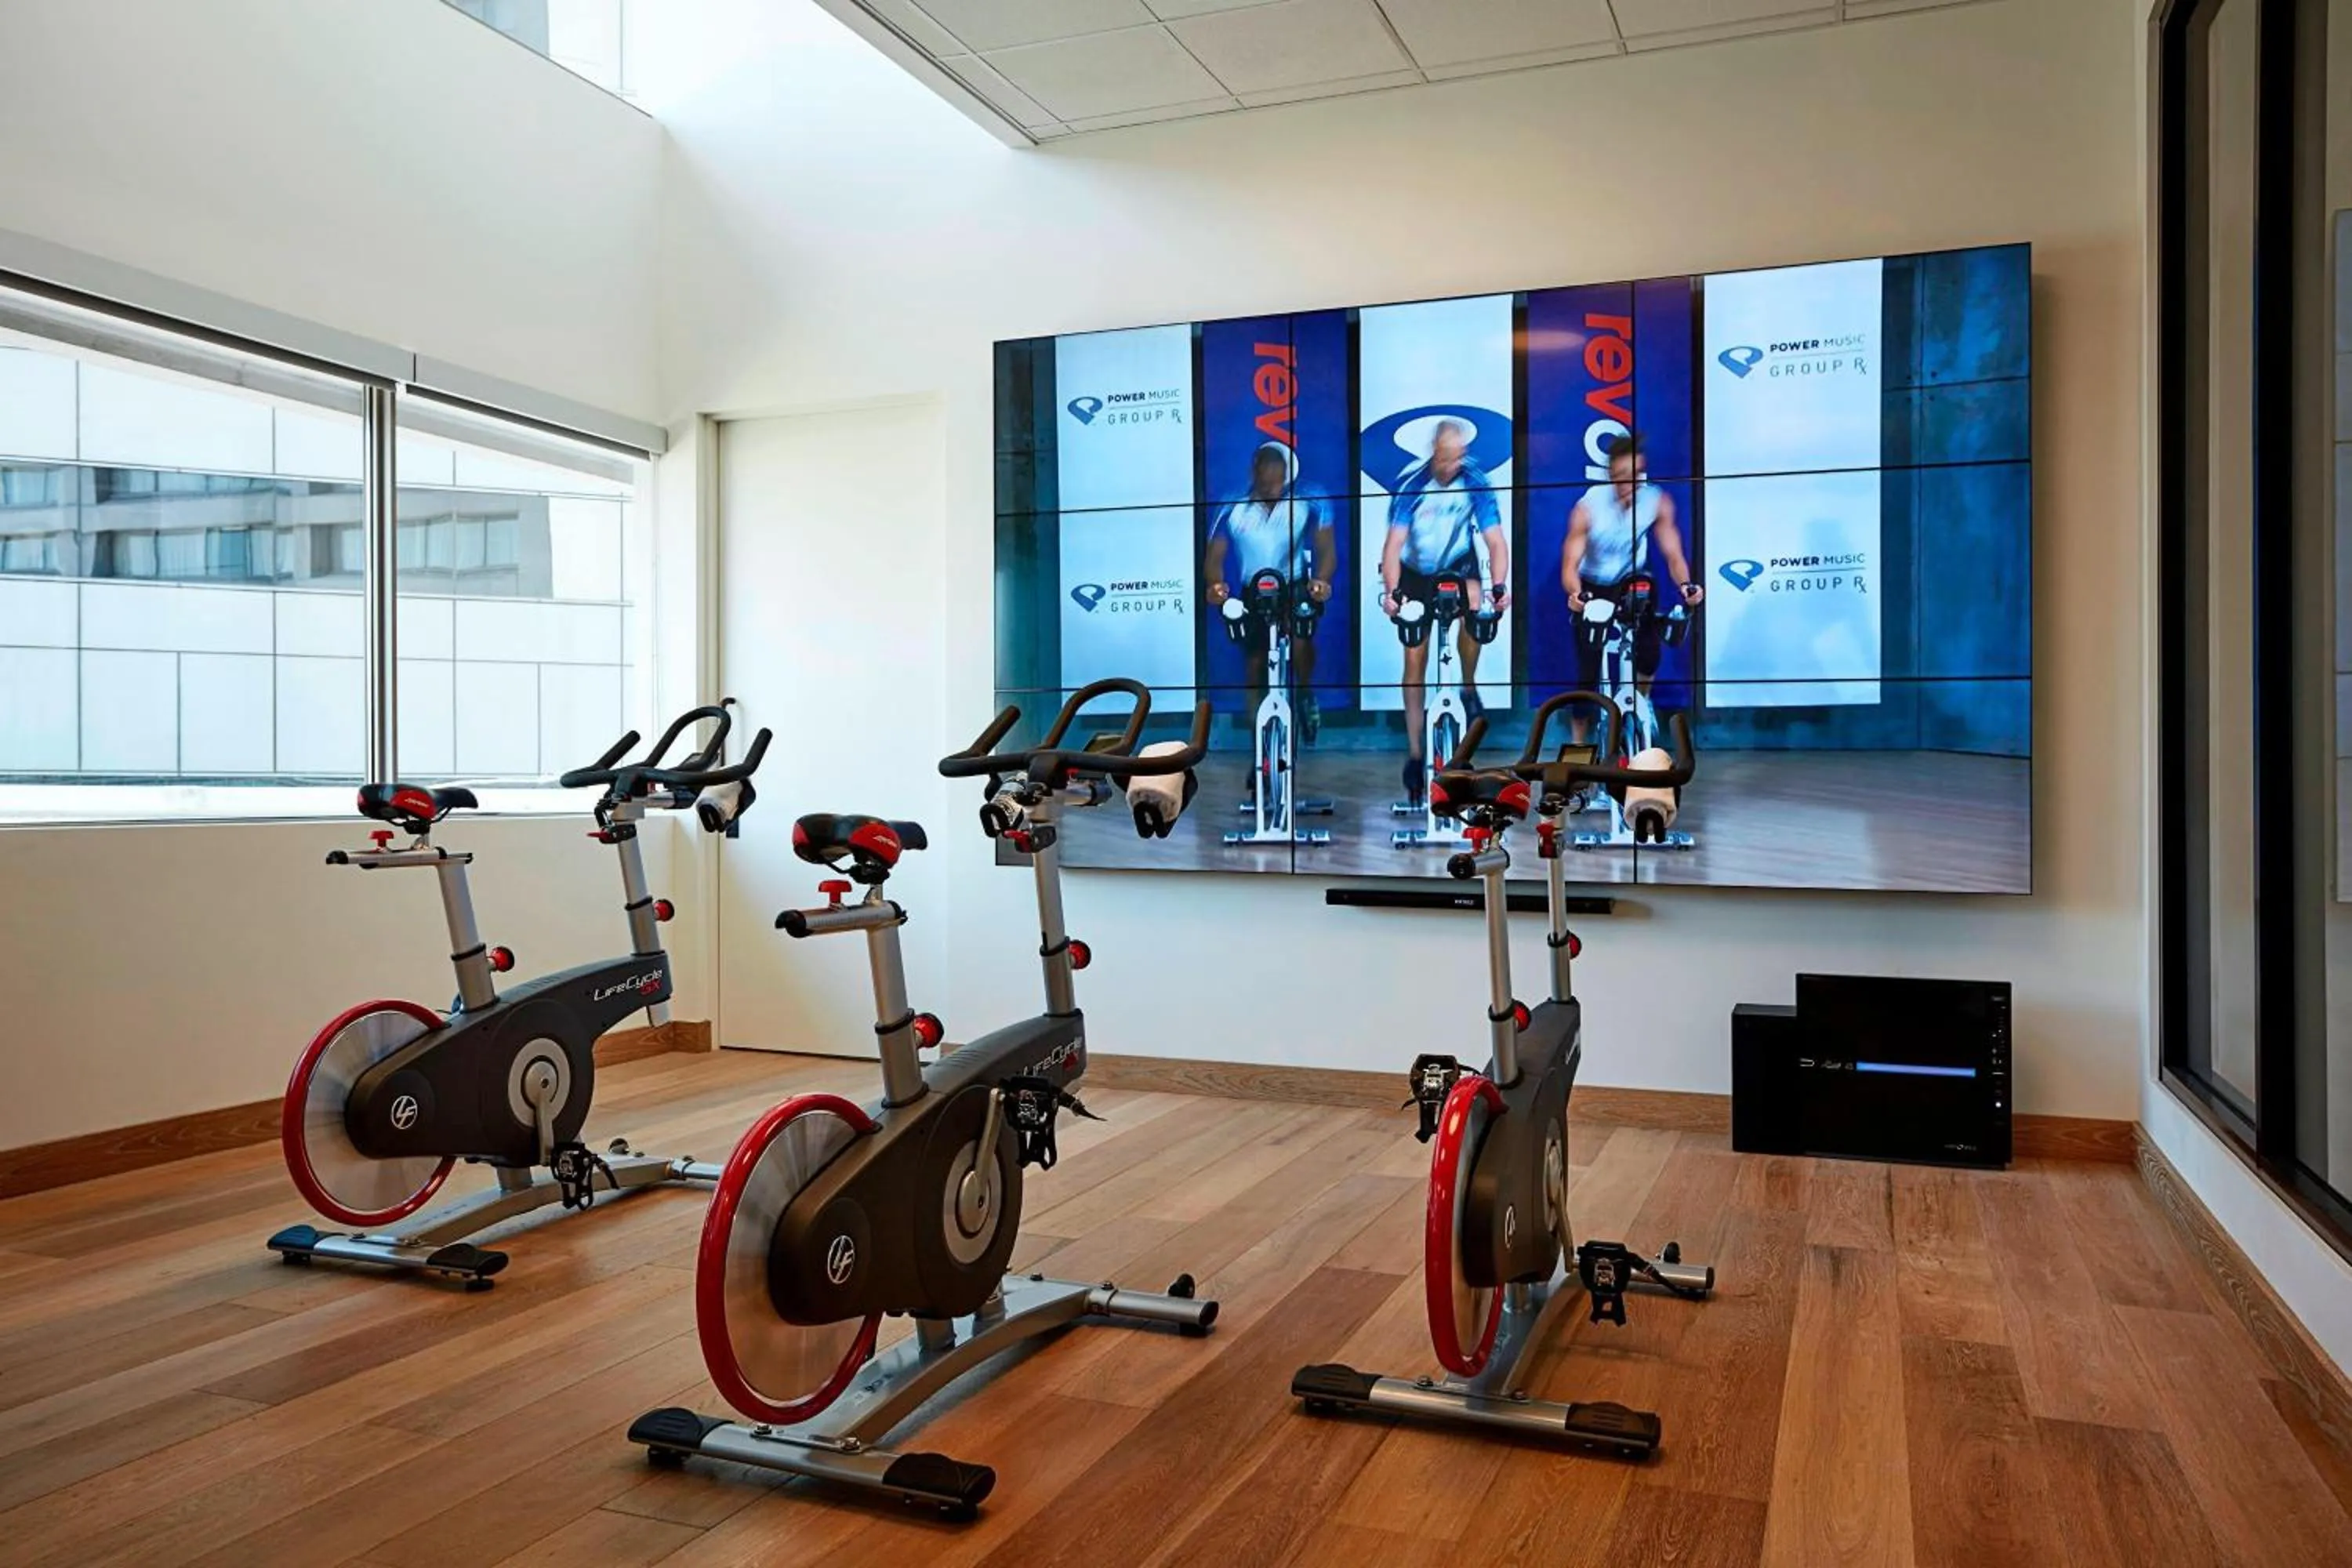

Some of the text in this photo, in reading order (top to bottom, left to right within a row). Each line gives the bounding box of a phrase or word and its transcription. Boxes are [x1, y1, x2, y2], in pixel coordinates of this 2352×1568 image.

[1769, 334, 1865, 352] POWER MUSIC
[1769, 359, 1842, 377] GROUP
[1108, 389, 1180, 403] POWER MUSIC
[1108, 410, 1163, 425] GROUP
[1770, 553, 1865, 567] POWER MUSIC
[1110, 579, 1183, 590] POWER MUSIC
[1770, 576, 1842, 592] GROUP
[1111, 600, 1166, 612] GROUP
